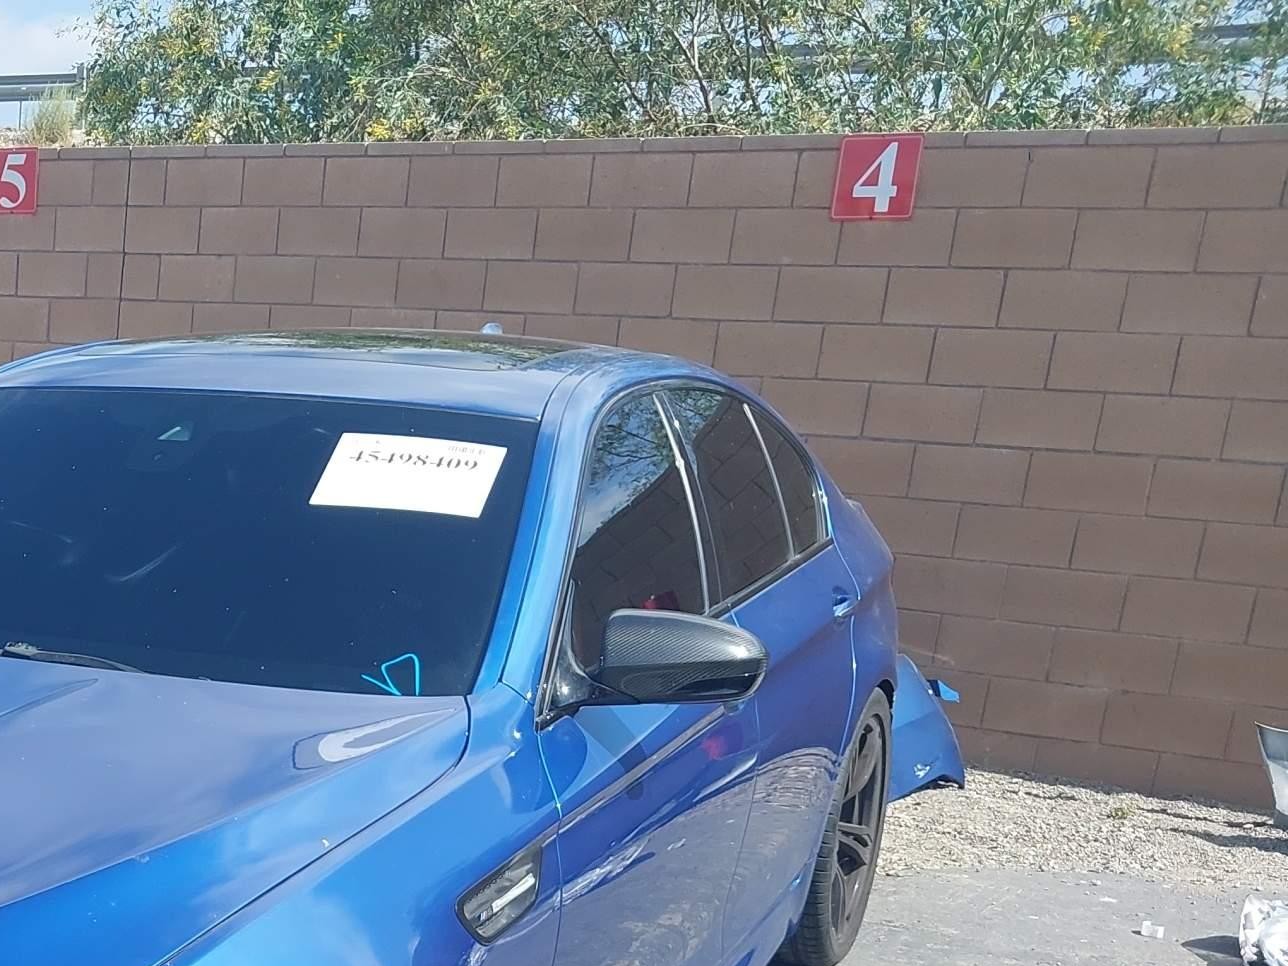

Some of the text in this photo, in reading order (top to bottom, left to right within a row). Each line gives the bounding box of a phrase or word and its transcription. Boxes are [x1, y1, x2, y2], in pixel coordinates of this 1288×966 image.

[0, 153, 27, 209] 5
[852, 141, 899, 213] 4
[349, 450, 478, 471] 45498409
